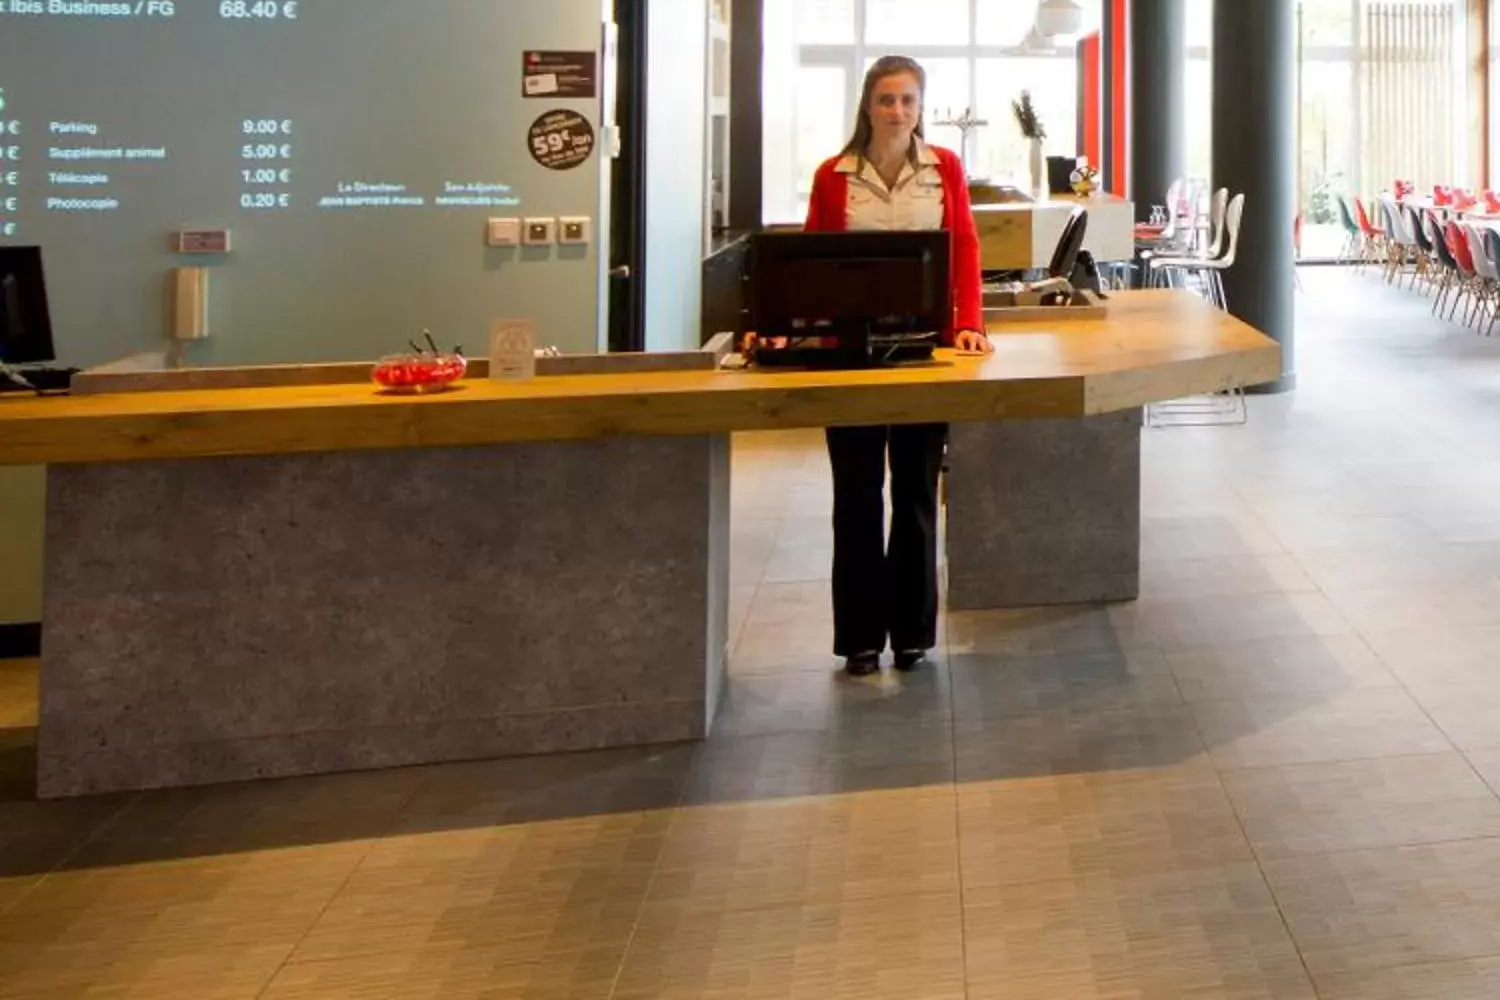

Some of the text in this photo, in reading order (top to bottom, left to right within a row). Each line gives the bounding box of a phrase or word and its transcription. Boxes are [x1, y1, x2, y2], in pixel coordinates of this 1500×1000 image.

[148, 1, 175, 17] FG
[219, 1, 298, 19] 68.40 €
[242, 144, 277, 159] 5.00
[241, 168, 276, 183] 1.00
[240, 193, 275, 208] 0.20
